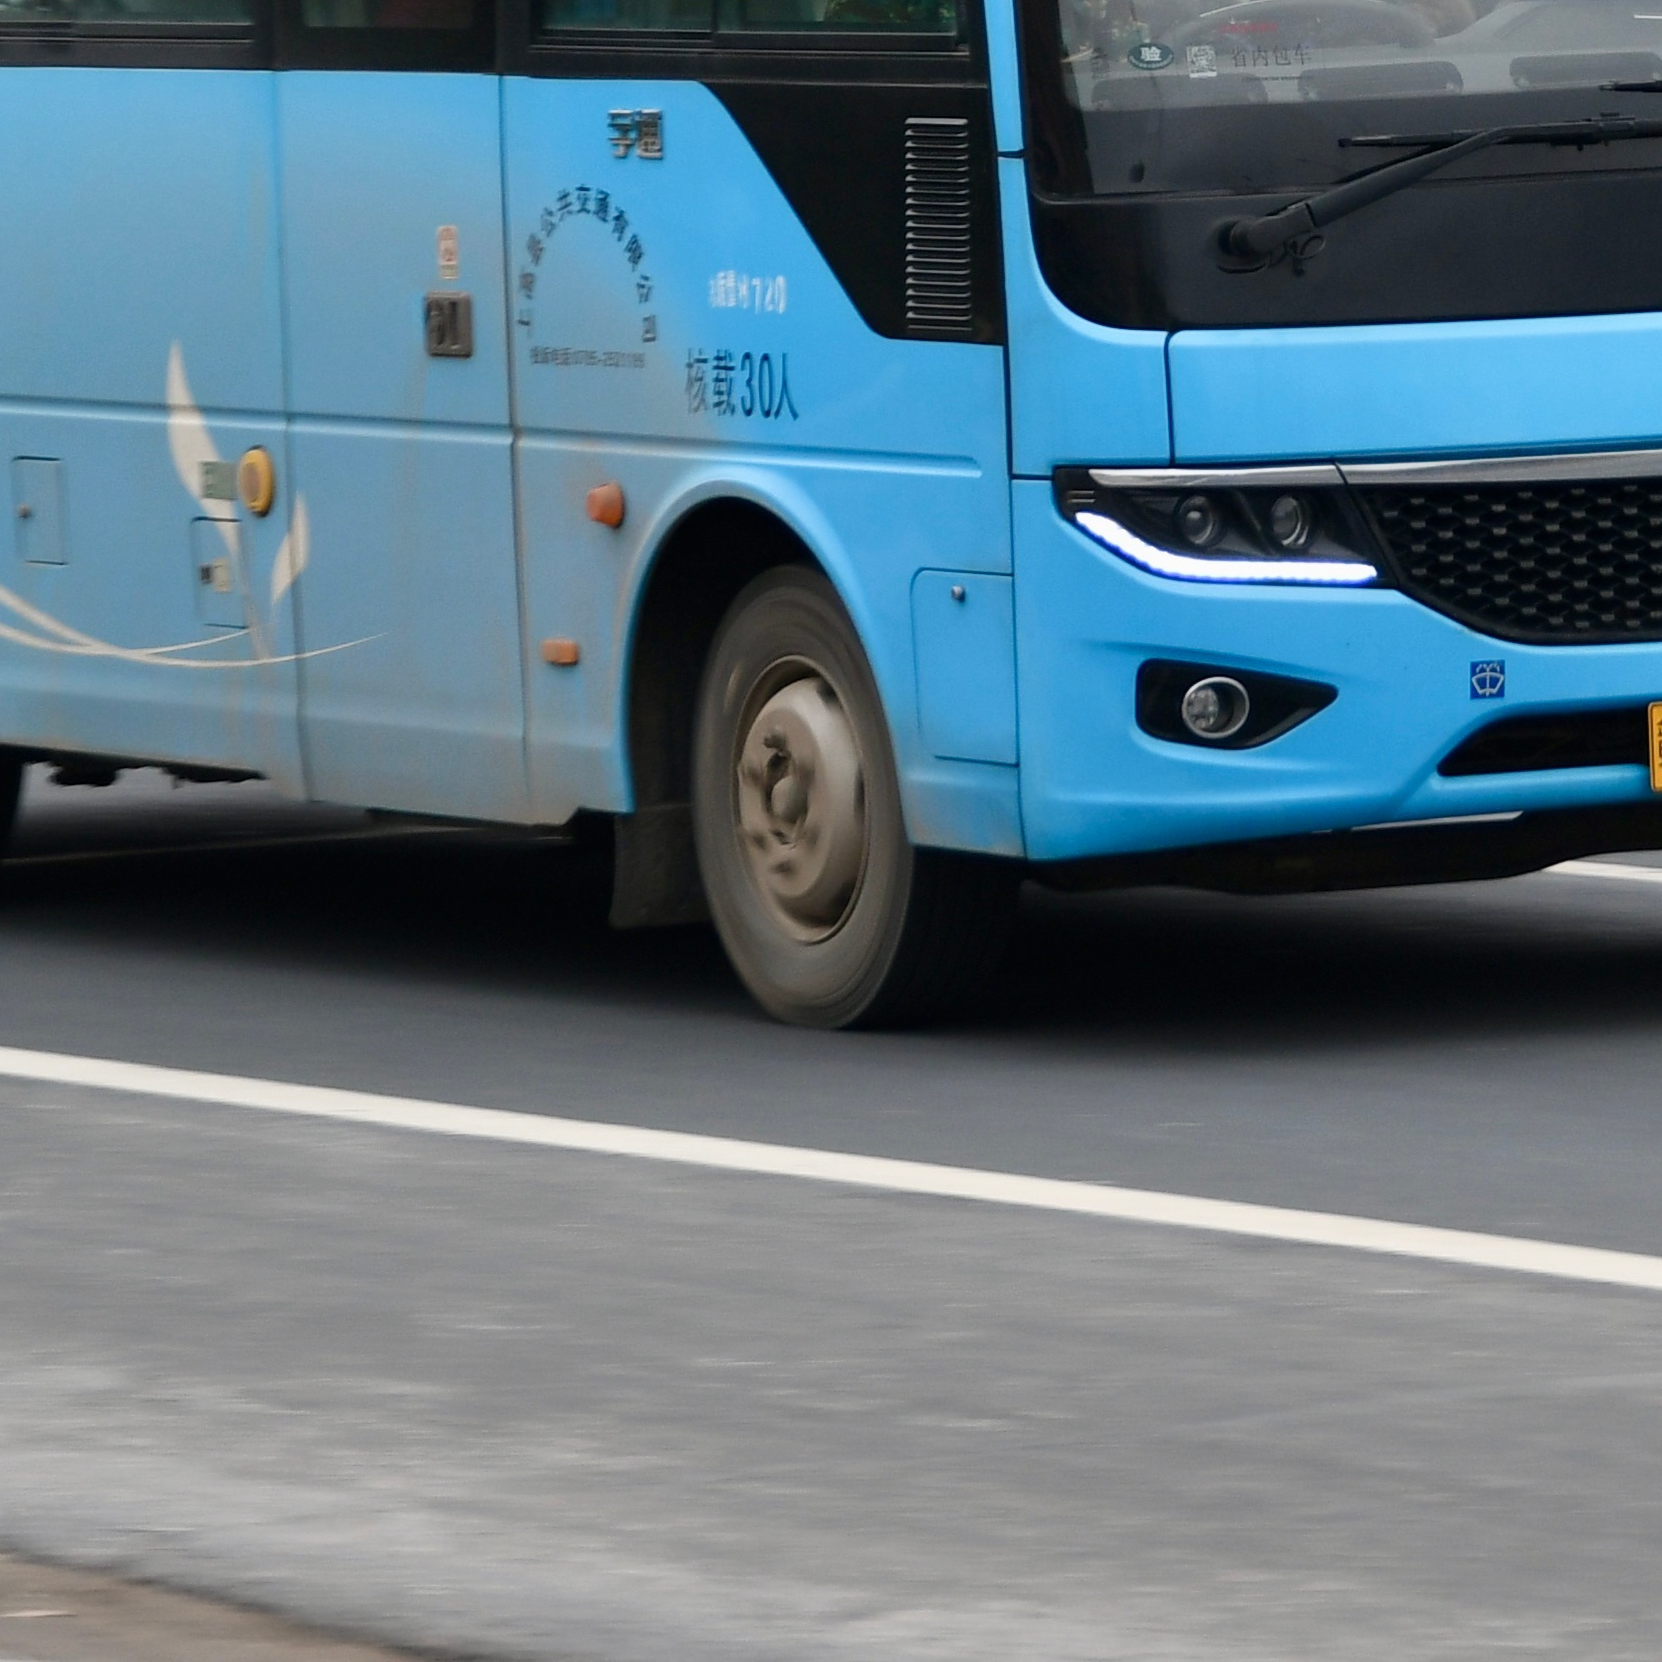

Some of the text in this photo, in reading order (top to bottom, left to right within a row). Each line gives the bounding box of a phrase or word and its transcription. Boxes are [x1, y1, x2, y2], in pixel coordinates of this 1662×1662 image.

[1140, 46, 1162, 62] 验
[684, 348, 799, 421] 核载30人
